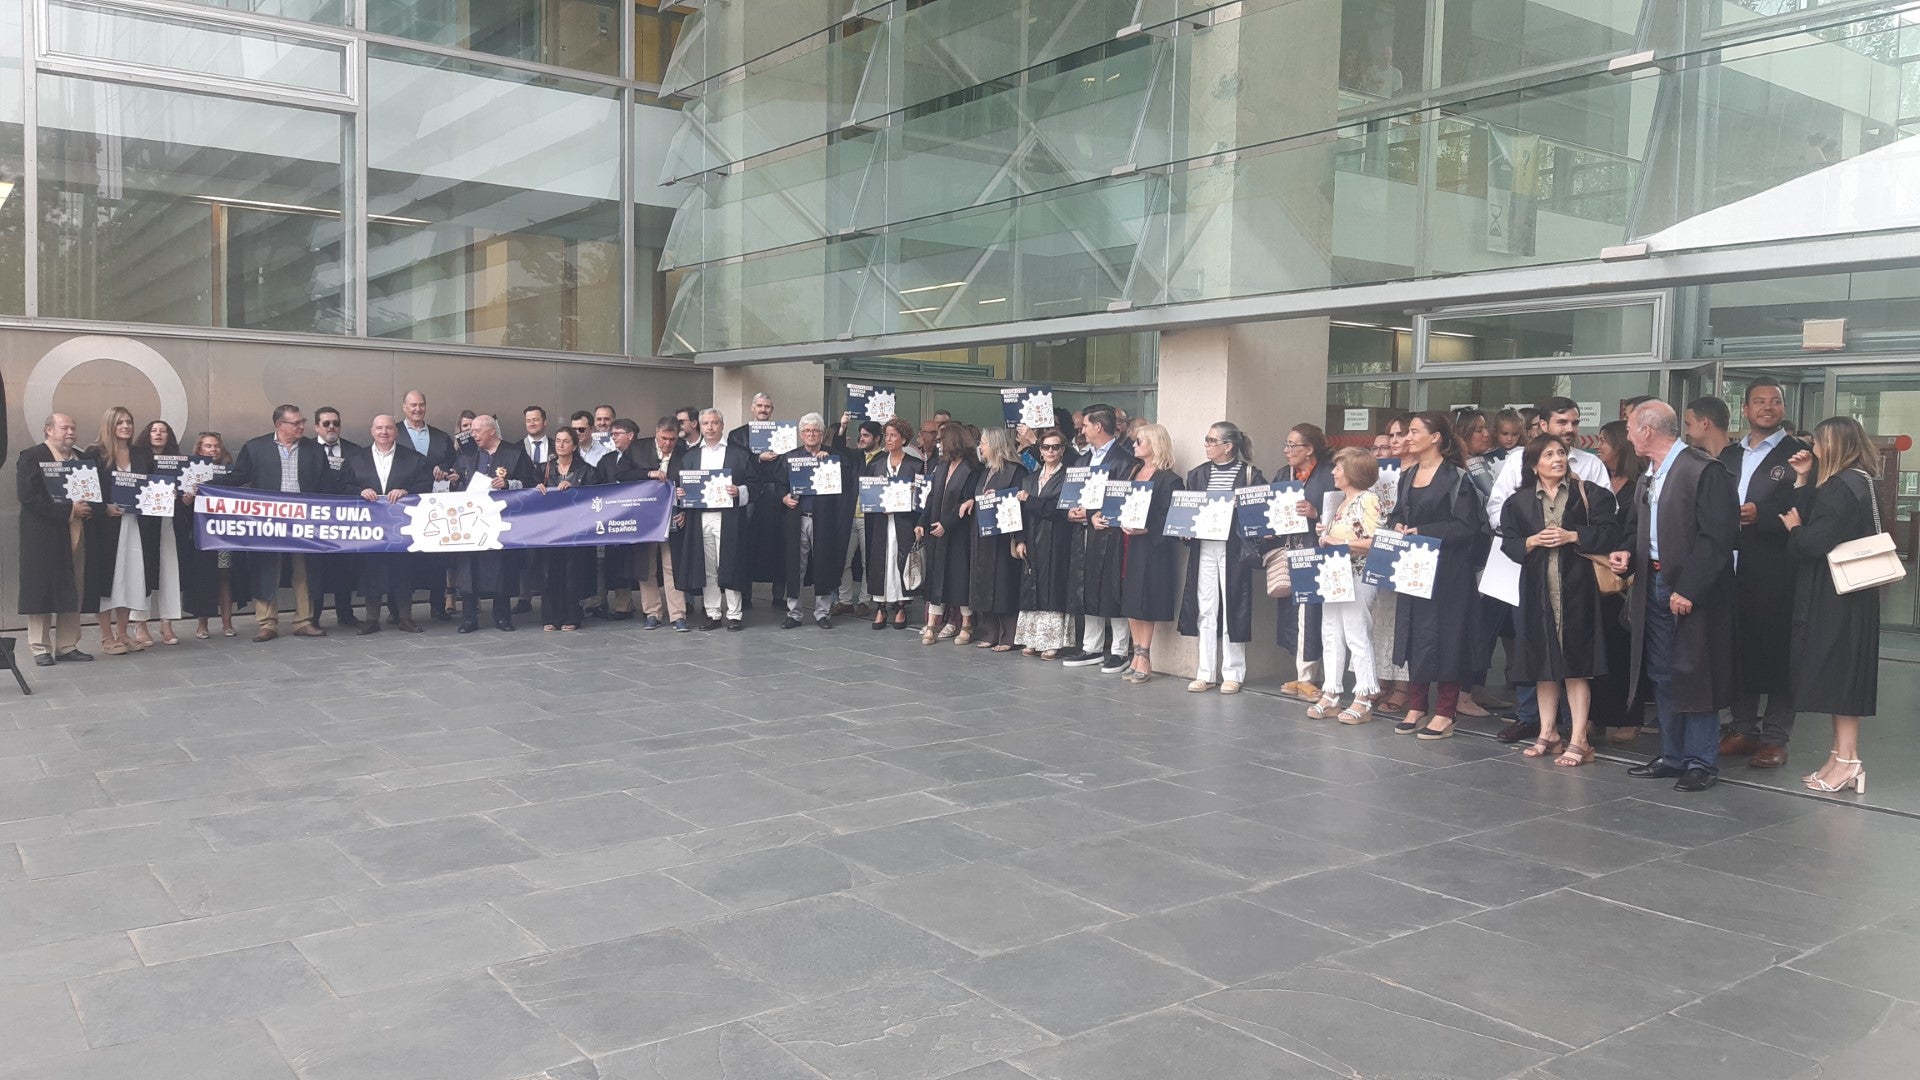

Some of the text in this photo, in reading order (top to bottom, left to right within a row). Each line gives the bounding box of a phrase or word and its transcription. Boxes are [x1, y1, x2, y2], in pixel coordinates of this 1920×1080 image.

[206, 498, 371, 522] LA JUSTICIA ES UNA
[206, 516, 384, 540] CUESTIÓN DE ESTADO
[608, 519, 636, 528] Abogacía
